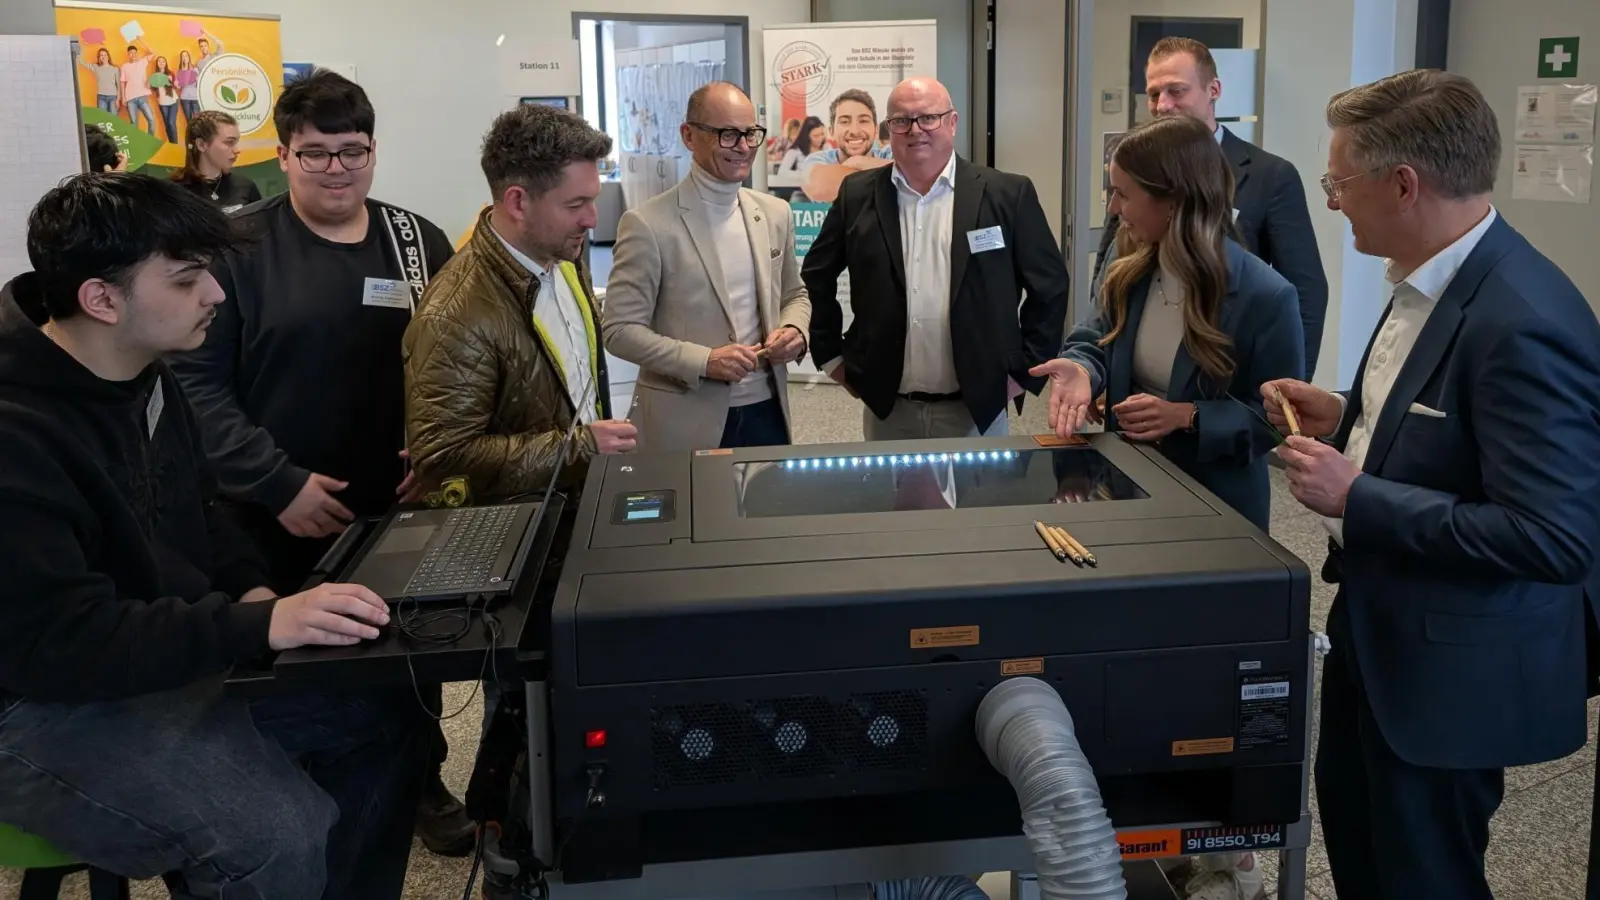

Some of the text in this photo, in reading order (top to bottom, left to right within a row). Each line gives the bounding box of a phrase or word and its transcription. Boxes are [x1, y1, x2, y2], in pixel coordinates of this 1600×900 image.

[211, 66, 257, 77] Persönliche
[519, 62, 560, 70] Station 11
[781, 62, 823, 83] STARK
[97, 122, 115, 133] ER
[112, 135, 129, 146] ES
[792, 210, 828, 228] TAR
[405, 246, 424, 299] didas
[1204, 832, 1281, 849] 8550_T94
